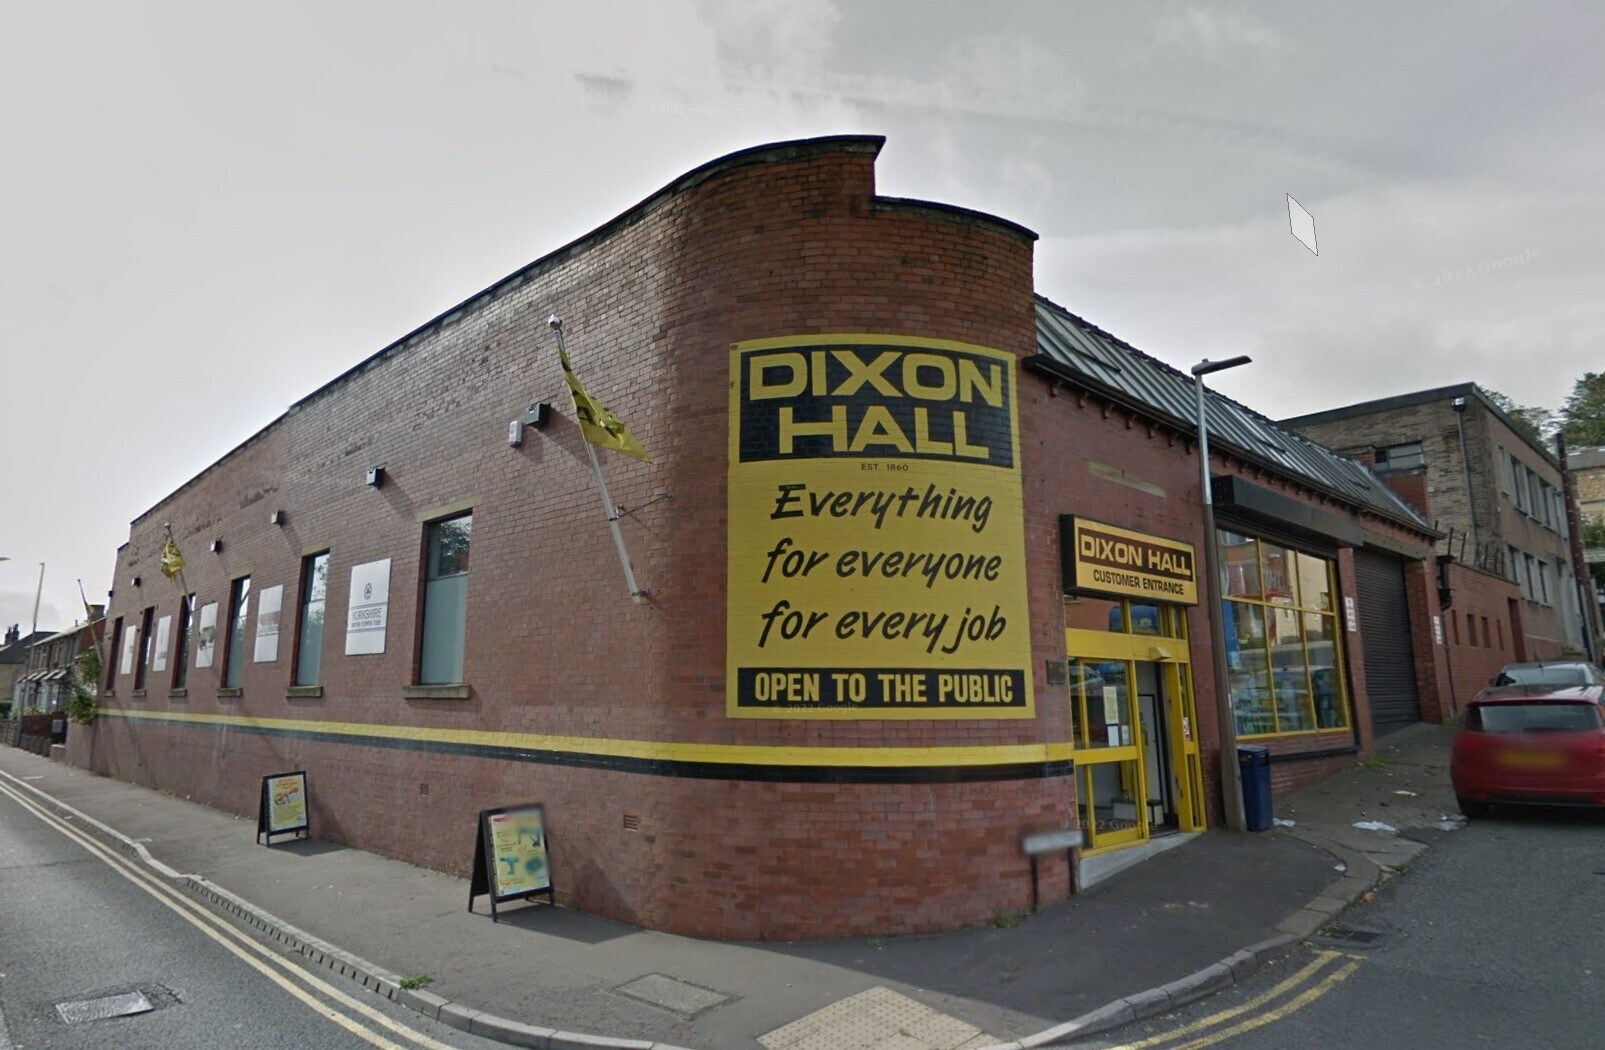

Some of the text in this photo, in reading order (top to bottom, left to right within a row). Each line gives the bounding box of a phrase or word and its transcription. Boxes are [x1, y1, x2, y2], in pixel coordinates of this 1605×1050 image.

[749, 351, 1003, 408] DIXON
[779, 405, 990, 459] HALL
[861, 463, 909, 471] EST. 1860
[770, 483, 993, 533] Everything
[761, 537, 1002, 588] for everyone
[1080, 534, 1191, 576] DIXON HALL
[1093, 569, 1184, 595] CUSTOMER ENTRANCE
[758, 600, 1006, 654] for every job
[754, 672, 1013, 703] OPEN TO THE PUBLIC
